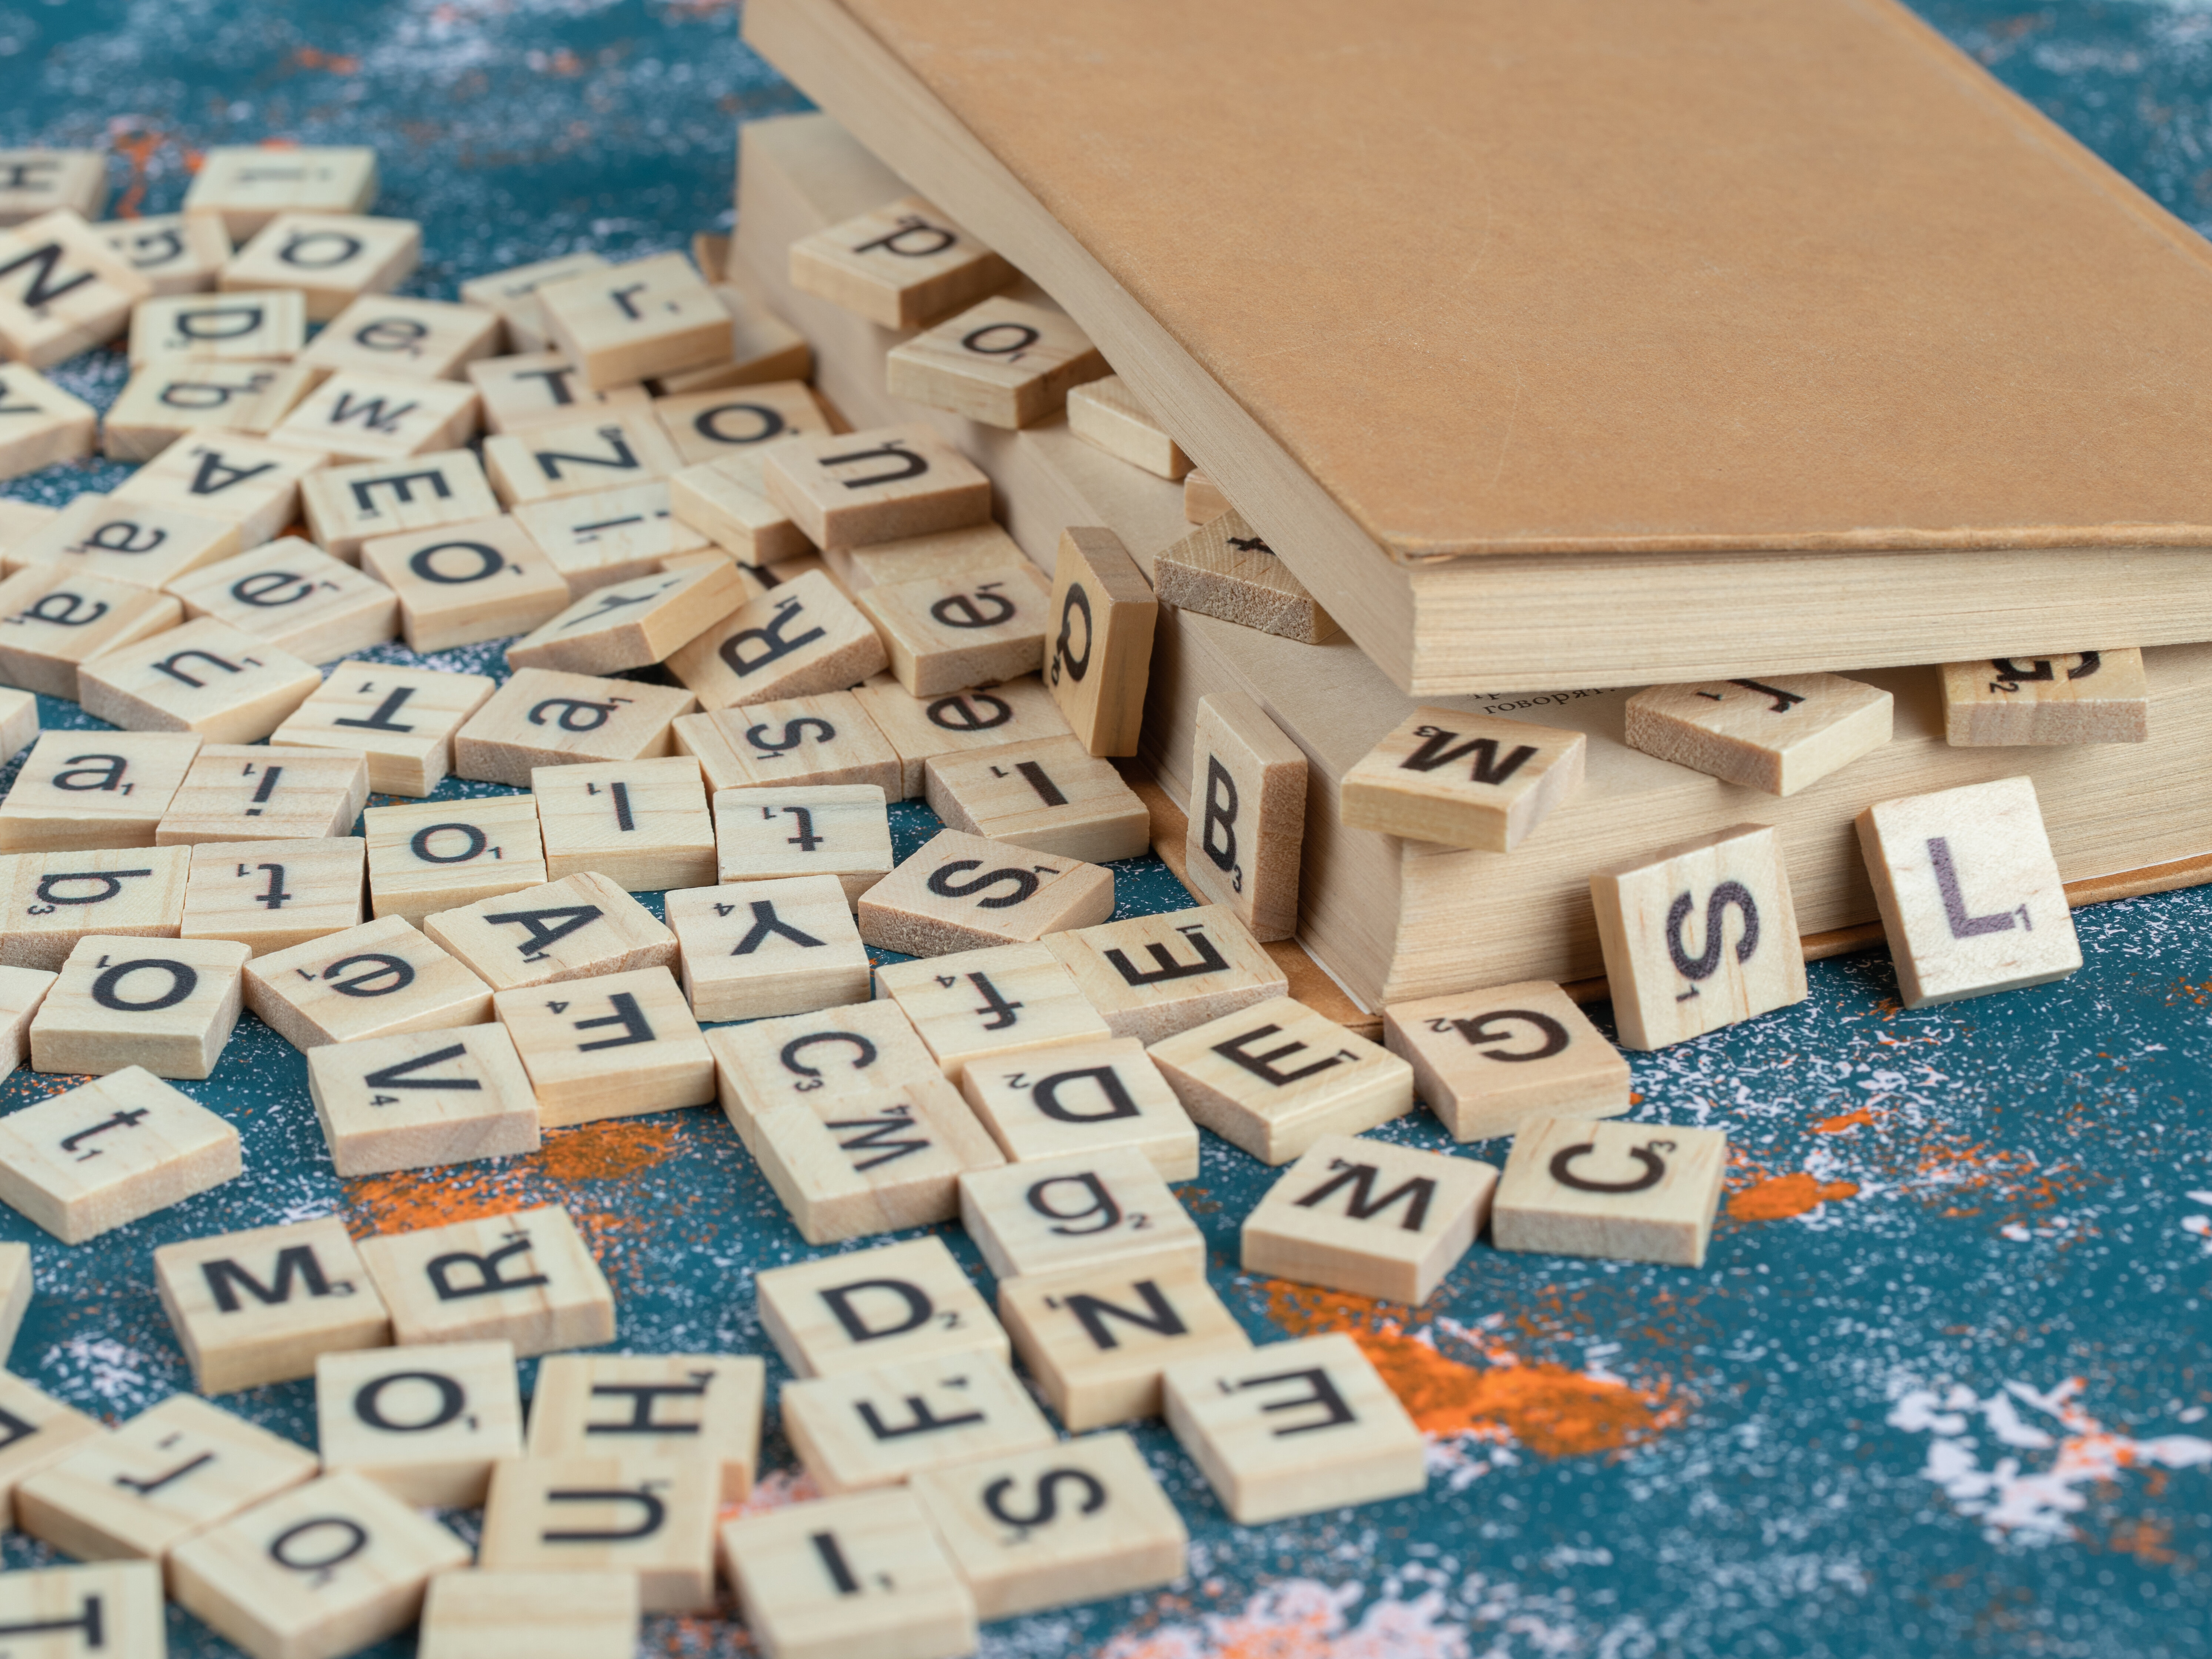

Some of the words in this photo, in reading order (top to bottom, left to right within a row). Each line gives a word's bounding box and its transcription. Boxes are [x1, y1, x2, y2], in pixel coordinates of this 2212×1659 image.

[609, 282, 647, 319] r
[176, 307, 264, 340] D
[354, 317, 430, 352] e
[512, 365, 578, 406] T
[189, 452, 281, 495] A
[349, 467, 454, 511] E
[83, 520, 167, 553] a
[571, 510, 671, 533] i
[408, 541, 504, 584] O
[504, 563, 525, 576] 1
[231, 571, 316, 607] e
[319, 580, 341, 591] 1
[930, 592, 1017, 628] e
[977, 581, 1004, 590] 1
[20, 592, 108, 626] a
[718, 601, 827, 677] R
[773, 595, 799, 609] 1
[1057, 582, 1092, 682] Q
[151, 649, 245, 688] n
[241, 657, 264, 668] 1
[358, 681, 375, 693] 1
[1696, 691, 1722, 701] 1
[1989, 681, 2020, 695] 2
[331, 687, 417, 732] T
[528, 697, 619, 732] a
[927, 694, 1013, 731] e
[53, 754, 129, 791] a
[120, 783, 134, 795] 1
[243, 763, 255, 776] 1
[757, 751, 784, 760] 1
[989, 765, 1010, 778] 1
[1399, 729, 1539, 786] M
[246, 767, 282, 816] i
[586, 782, 602, 795] 1
[761, 807, 778, 820] 1
[781, 807, 824, 852] t
[1203, 752, 1238, 872] B
[1232, 864, 1243, 894] 3
[236, 863, 252, 877] 1
[486, 845, 503, 859] 1
[1033, 865, 1061, 875] 1
[36, 869, 152, 905] b
[255, 863, 292, 909] t
[1925, 835, 2018, 939] L
[2013, 902, 2034, 933] 1
[27, 904, 56, 915] 3
[713, 902, 736, 917] 4
[730, 899, 828, 956] Y
[483, 904, 605, 957] A
[95, 955, 111, 969] 1
[522, 951, 551, 964] 1
[1103, 932, 1231, 987] E
[1175, 924, 1205, 935] 1
[91, 958, 198, 1012] O
[296, 968, 317, 982] 1
[323, 953, 416, 998] e
[934, 974, 957, 989] 4
[1675, 982, 1701, 1004] 1
[546, 1000, 571, 1015] 4
[964, 972, 1025, 1031] f
[573, 991, 657, 1053] F
[1423, 1017, 1454, 1034] 2
[1452, 1009, 1571, 1063] G
[1211, 1023, 1344, 1088] E
[1335, 1048, 1362, 1064] 1
[368, 1094, 401, 1106] 4
[794, 1077, 825, 1093] 3
[1002, 1072, 1031, 1090] 2
[1031, 1065, 1142, 1124] D
[60, 1107, 152, 1152] t
[881, 1105, 912, 1118] 4
[75, 1149, 104, 1164] 1
[1647, 1139, 1678, 1154] 3
[1027, 1171, 1123, 1237] g
[1125, 1212, 1155, 1230] 2
[200, 1244, 331, 1313] M
[425, 1236, 550, 1308] R
[818, 1278, 935, 1343] D
[1063, 1278, 1190, 1352] N
[584, 1384, 706, 1435] H
[853, 1394, 987, 1442] F
[1236, 1366, 1359, 1438] E
[541, 1490, 667, 1543] U
